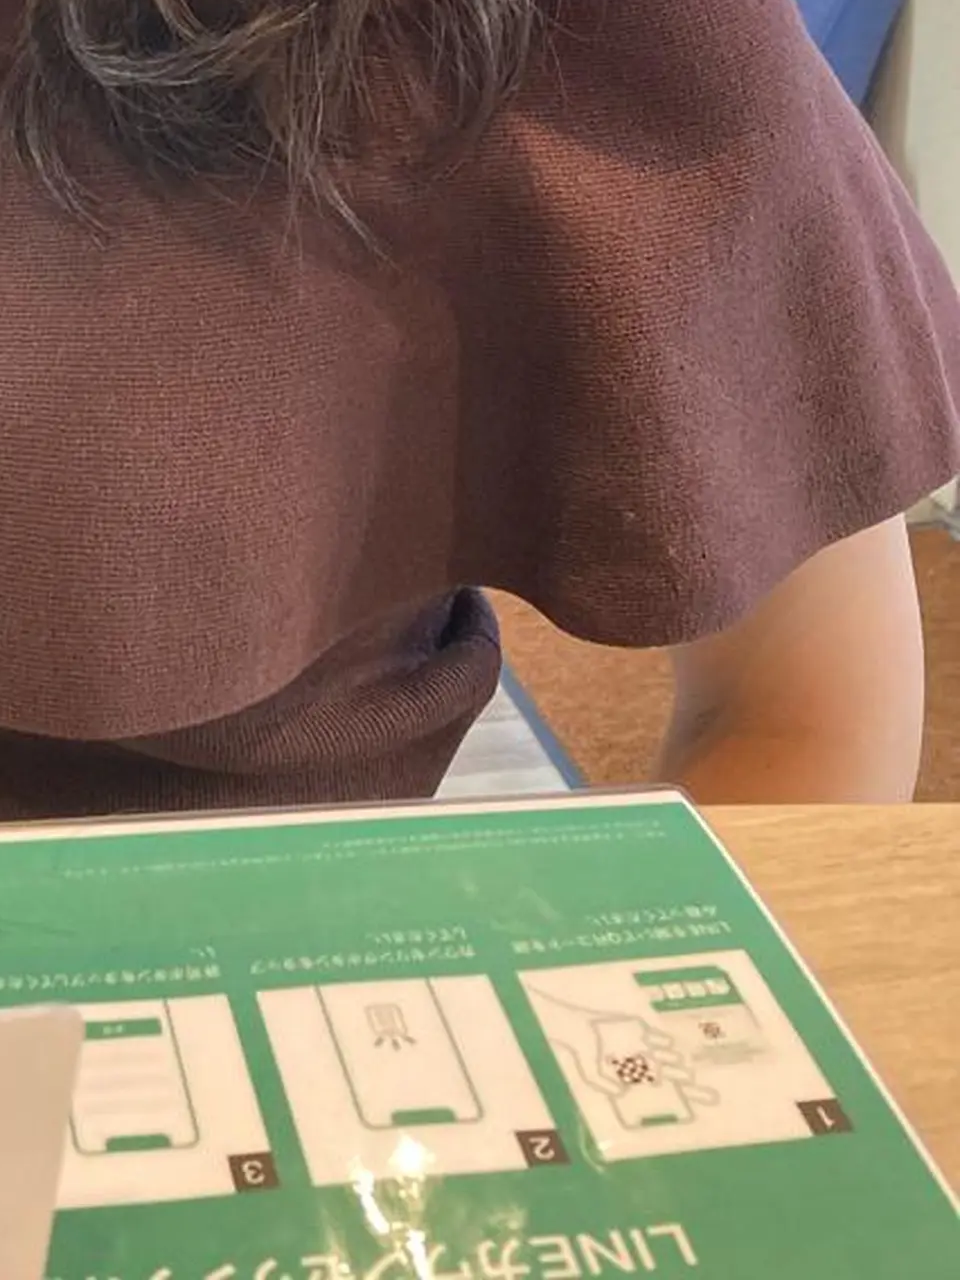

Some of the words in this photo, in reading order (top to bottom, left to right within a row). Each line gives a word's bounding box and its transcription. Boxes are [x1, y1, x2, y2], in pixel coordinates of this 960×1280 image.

[816, 1106, 835, 1129] 1
[528, 1136, 555, 1160] 2
[240, 1160, 266, 1184] 3
